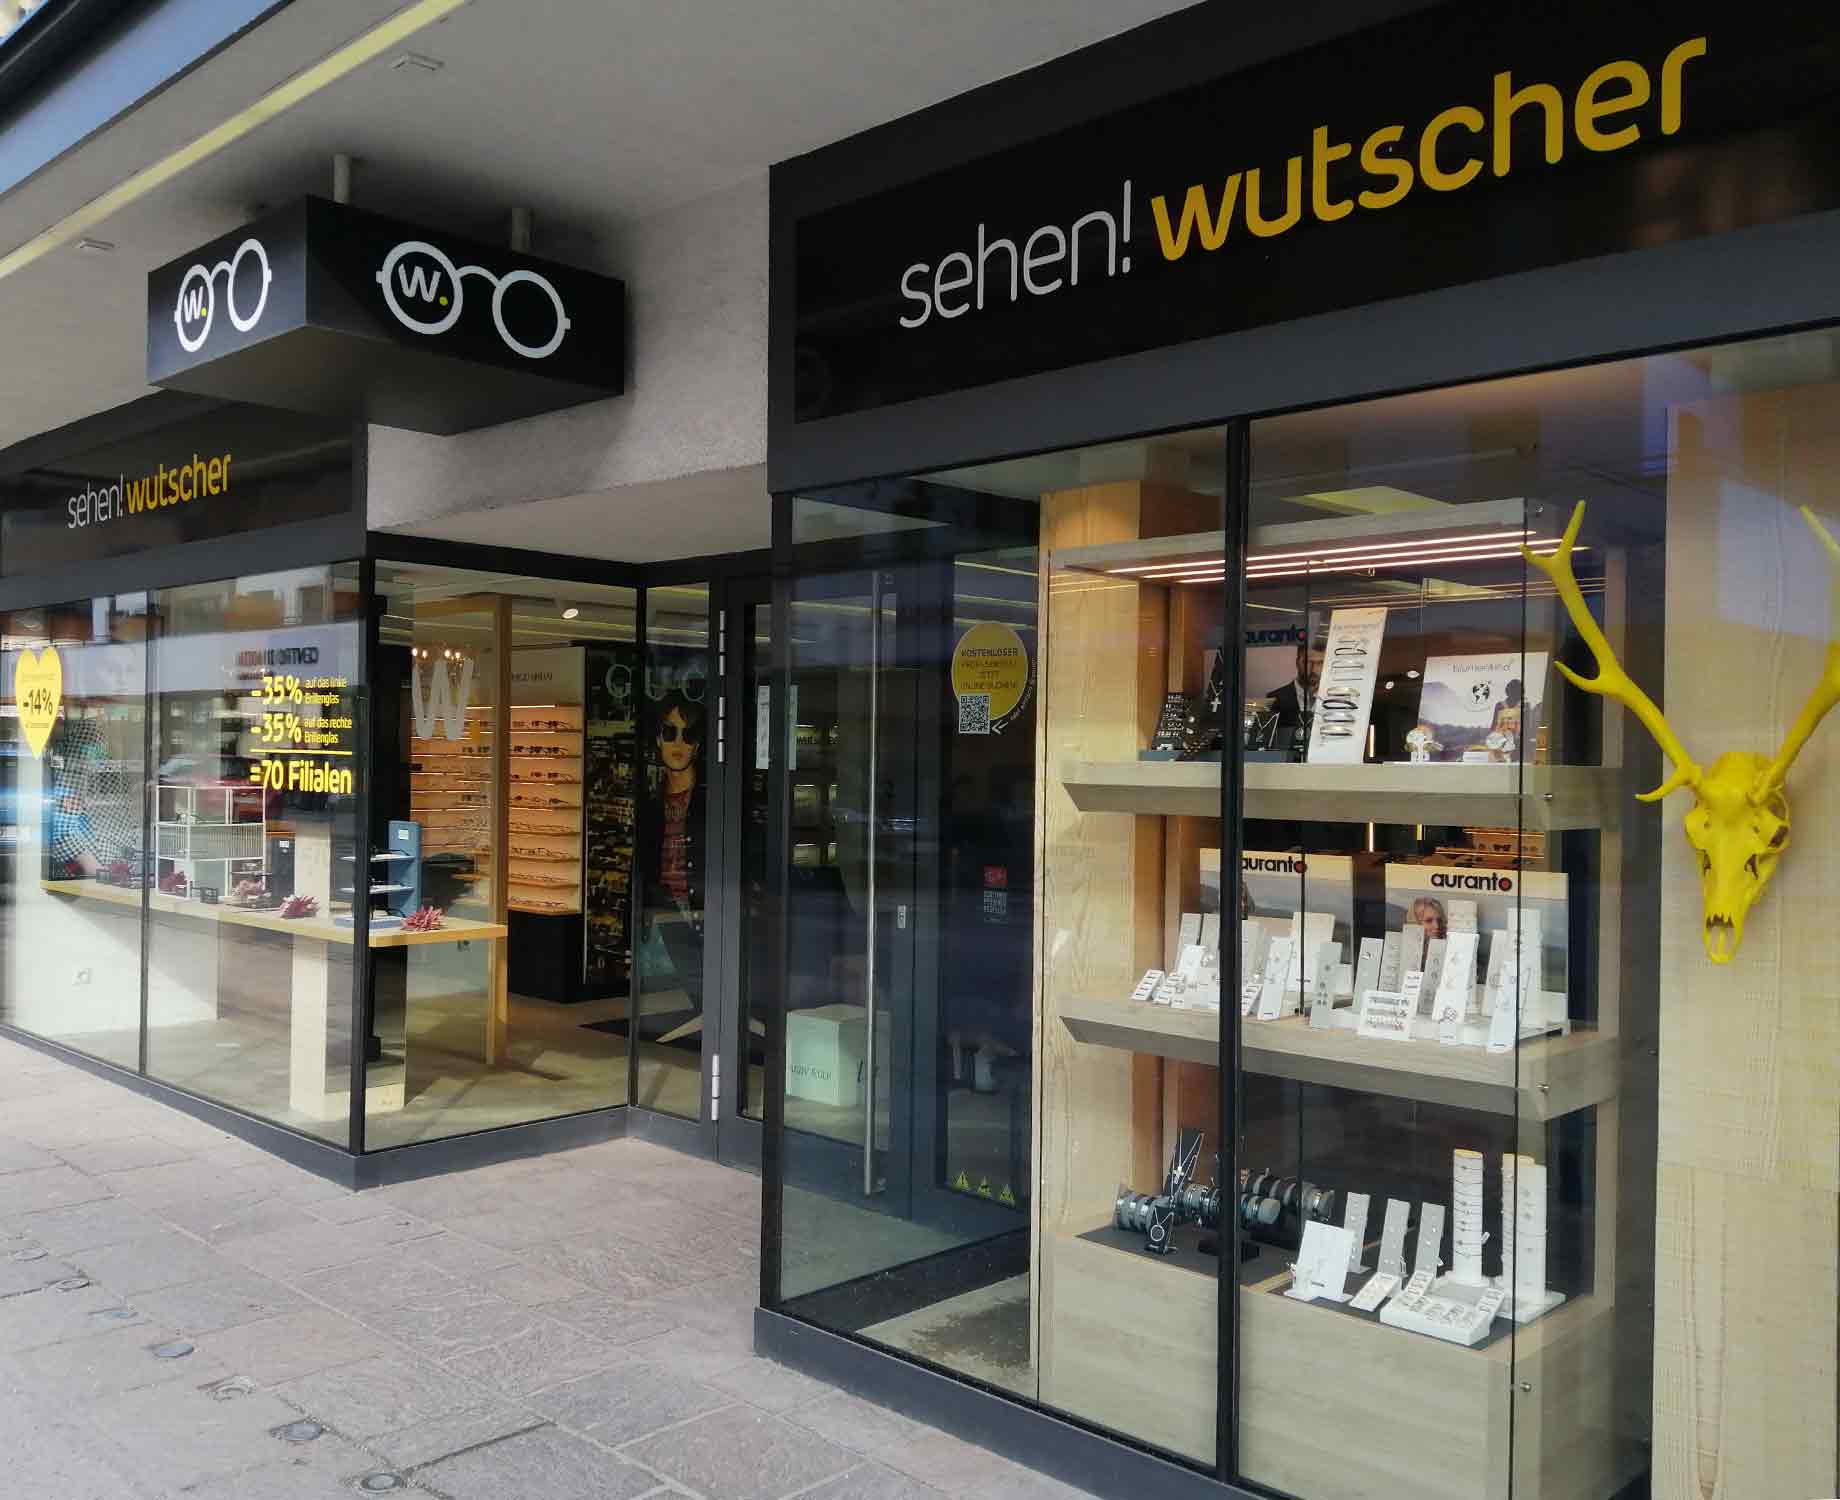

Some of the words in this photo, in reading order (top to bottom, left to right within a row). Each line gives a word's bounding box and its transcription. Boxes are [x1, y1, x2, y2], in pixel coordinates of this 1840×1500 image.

[898, 179, 1134, 330] sehen!
[1150, 36, 1708, 262] wutscher
[67, 472, 124, 529] sehen!
[126, 453, 232, 514] wutscher
[23, 688, 53, 716] -14%
[250, 675, 303, 705] -35%
[250, 713, 303, 743] -35%
[288, 759, 353, 795] Filialen
[1431, 871, 1512, 892] auranto
